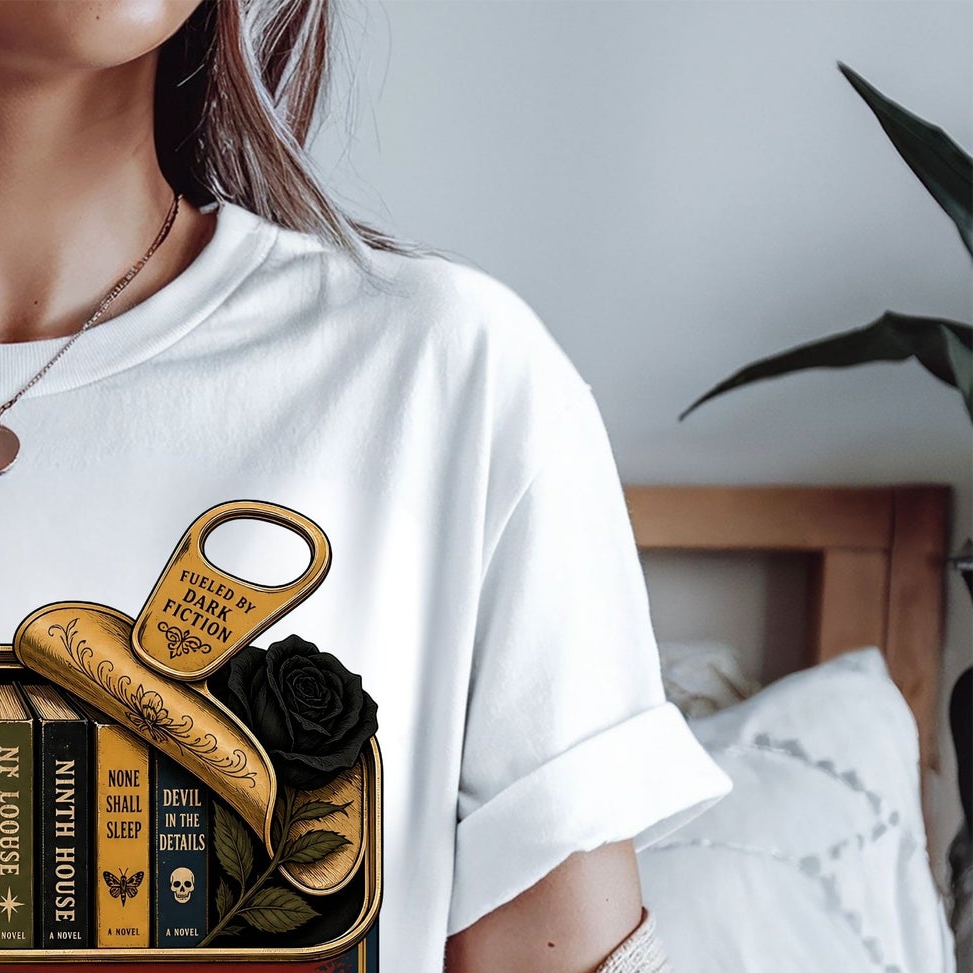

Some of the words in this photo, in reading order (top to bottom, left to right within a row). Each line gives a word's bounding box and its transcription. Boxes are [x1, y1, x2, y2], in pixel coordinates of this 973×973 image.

[179, 570, 234, 601] FUELED
[236, 596, 257, 614] BY
[182, 588, 234, 623] DARK
[162, 599, 233, 643] FICTION
[108, 769, 140, 787] NONE
[55, 759, 76, 838] NINTH
[106, 795, 142, 813] SHALL
[163, 789, 202, 807] DEVIL
[106, 821, 142, 839] SLEEP
[165, 814, 177, 828] IN
[179, 814, 200, 828] THE
[159, 833, 205, 852] DETAILS
[55, 847, 76, 922] HOUSE
[1, 930, 26, 940] NOVEL
[49, 930, 55, 940] A
[57, 930, 82, 940] NOVEL
[108, 927, 113, 936] A
[115, 927, 140, 936] NOVEL
[165, 927, 171, 937] A
[173, 927, 199, 937] NOVEL
